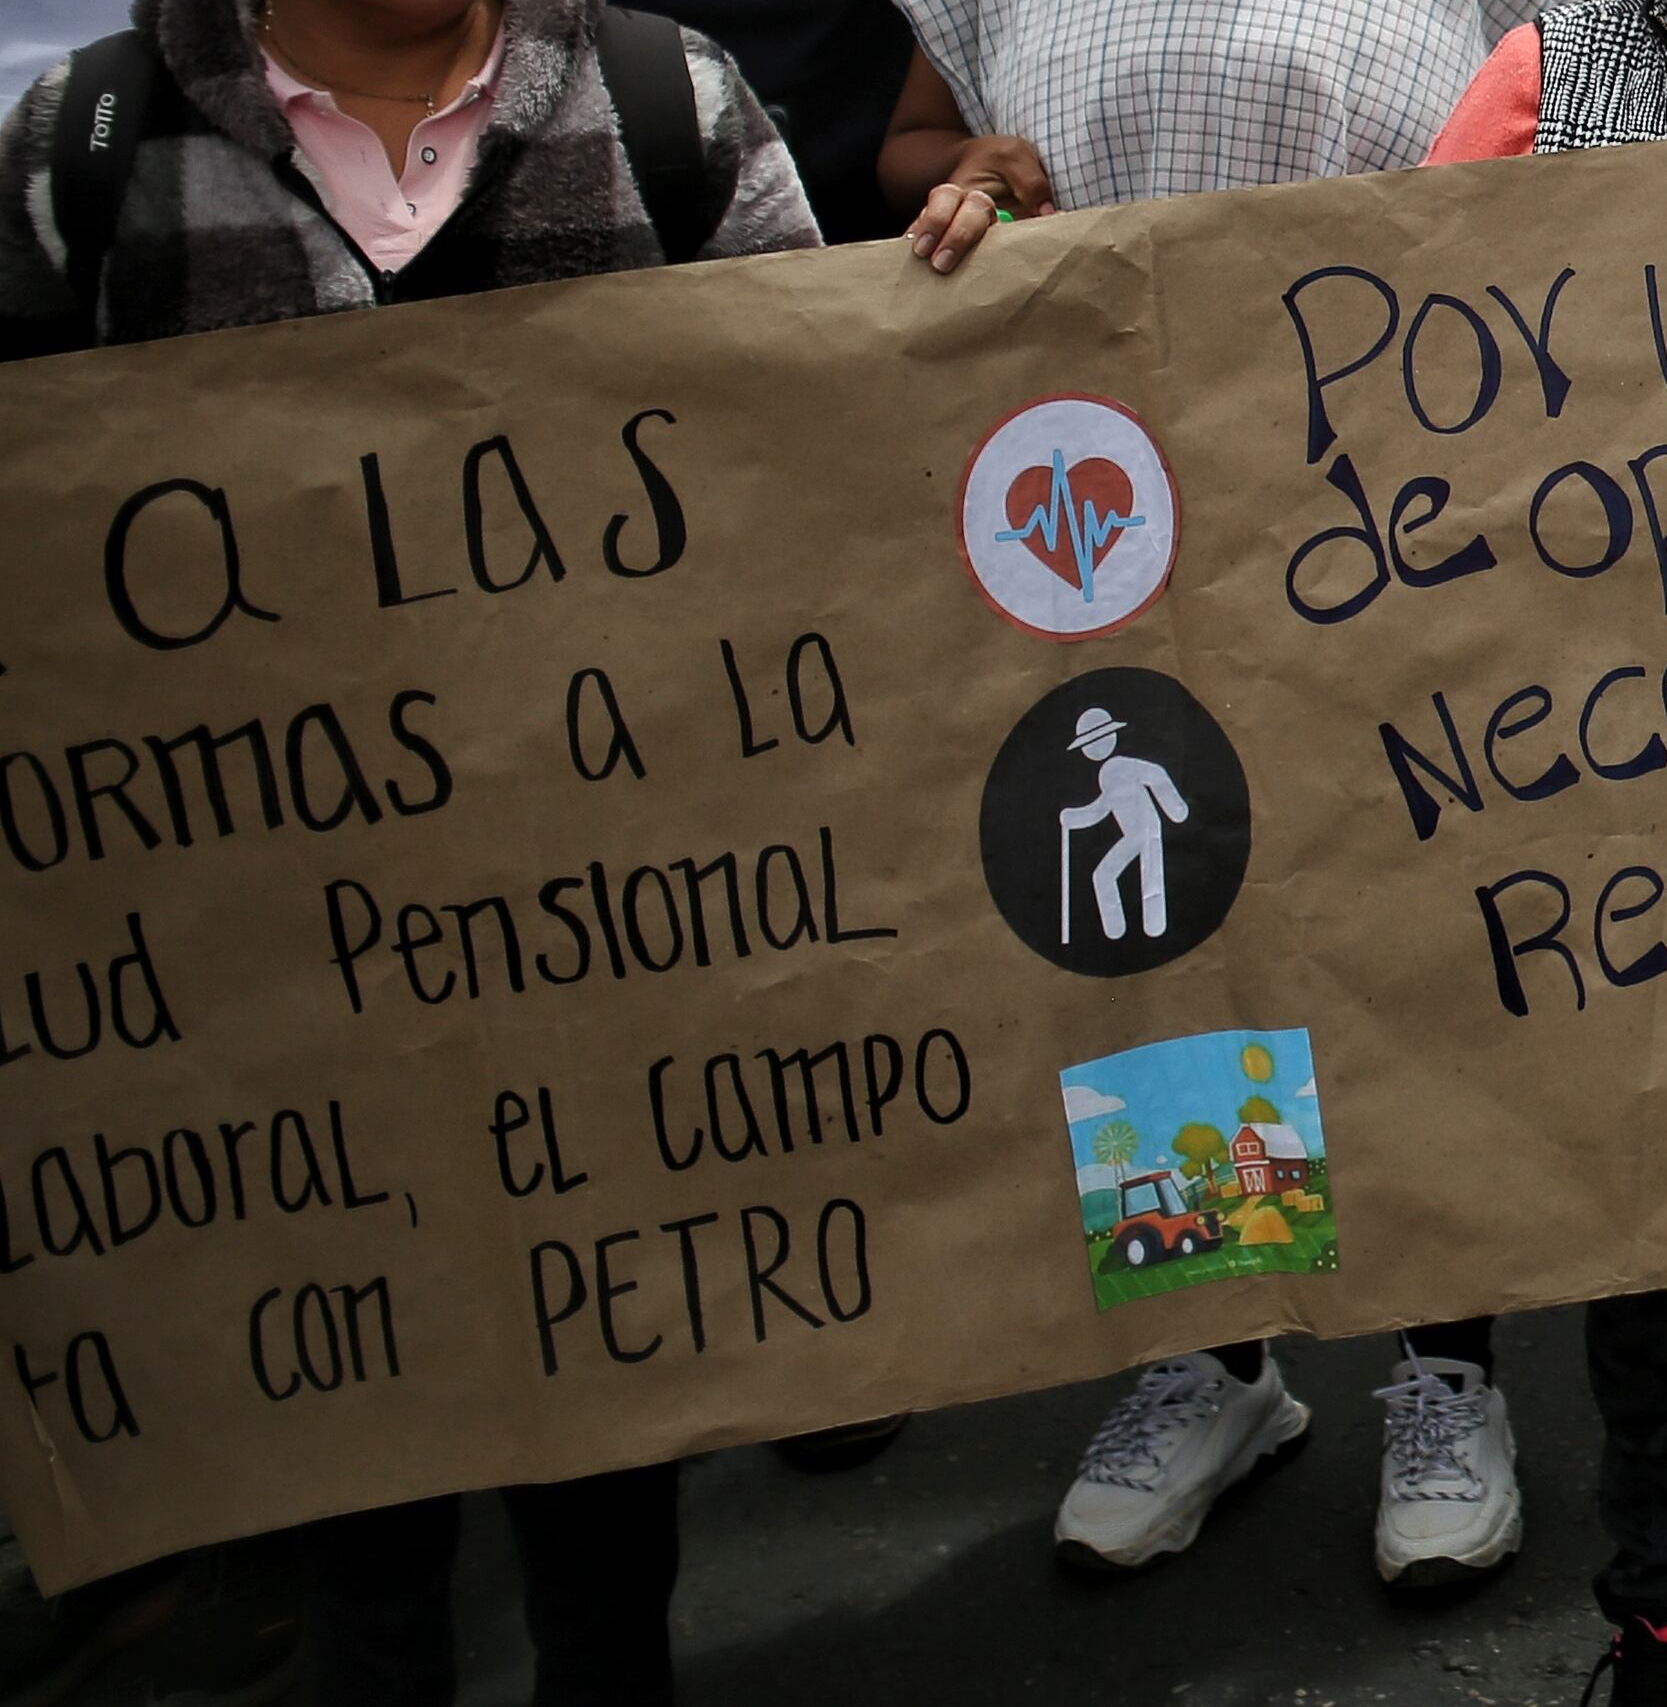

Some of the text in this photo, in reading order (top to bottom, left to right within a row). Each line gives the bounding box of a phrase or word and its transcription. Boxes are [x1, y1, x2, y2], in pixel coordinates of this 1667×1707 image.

[90, 92, 115, 151] TOTTO
[1285, 454, 1496, 625] de
[529, 1197, 875, 1377] PETRO
